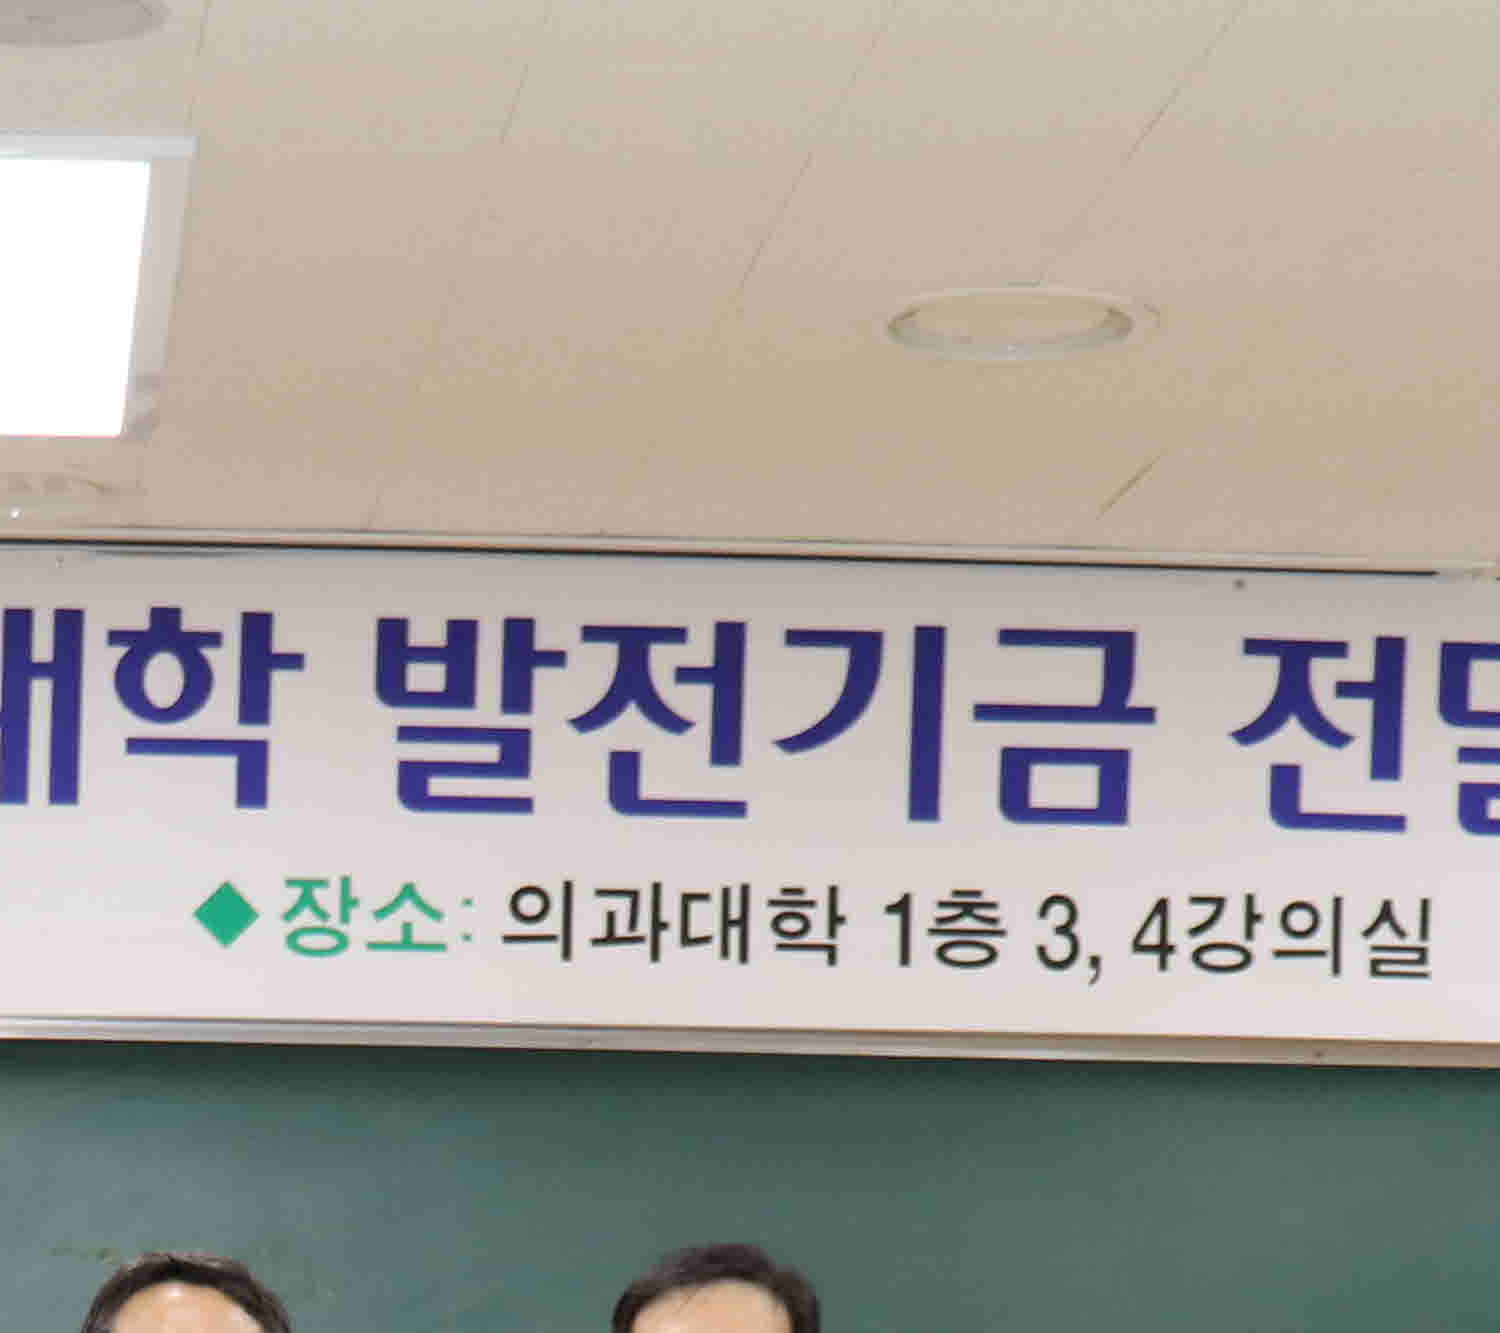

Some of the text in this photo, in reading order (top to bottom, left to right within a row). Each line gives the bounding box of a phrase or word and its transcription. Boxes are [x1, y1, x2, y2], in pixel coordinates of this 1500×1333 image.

[374, 617, 1156, 828] 발전기금
[281, 875, 474, 960] 장소:
[502, 879, 847, 967] 의과대학
[884, 889, 1007, 969] 1층
